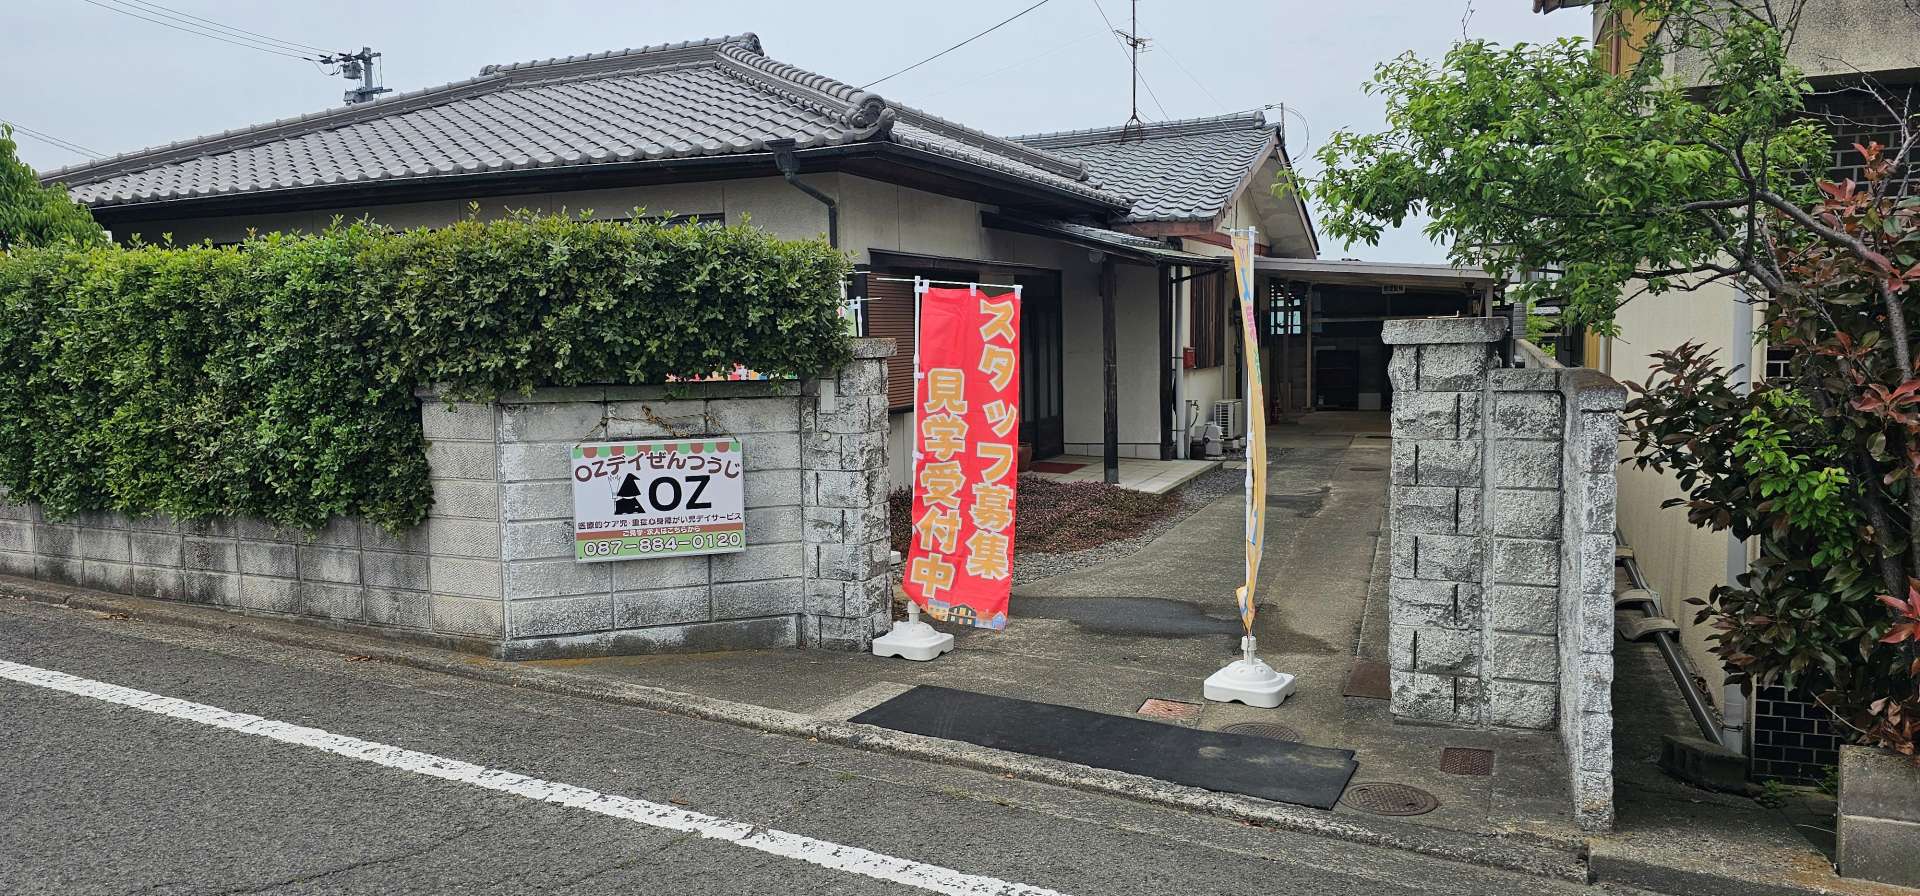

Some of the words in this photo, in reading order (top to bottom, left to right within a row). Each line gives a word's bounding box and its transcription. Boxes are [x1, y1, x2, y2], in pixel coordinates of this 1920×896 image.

[969, 299, 1015, 580] スタッフ募集
[575, 452, 740, 482] OZデイぜんつうじ
[911, 368, 967, 597] 見学受付中
[648, 475, 712, 512] OZ
[584, 533, 742, 557] 087-884-0120
